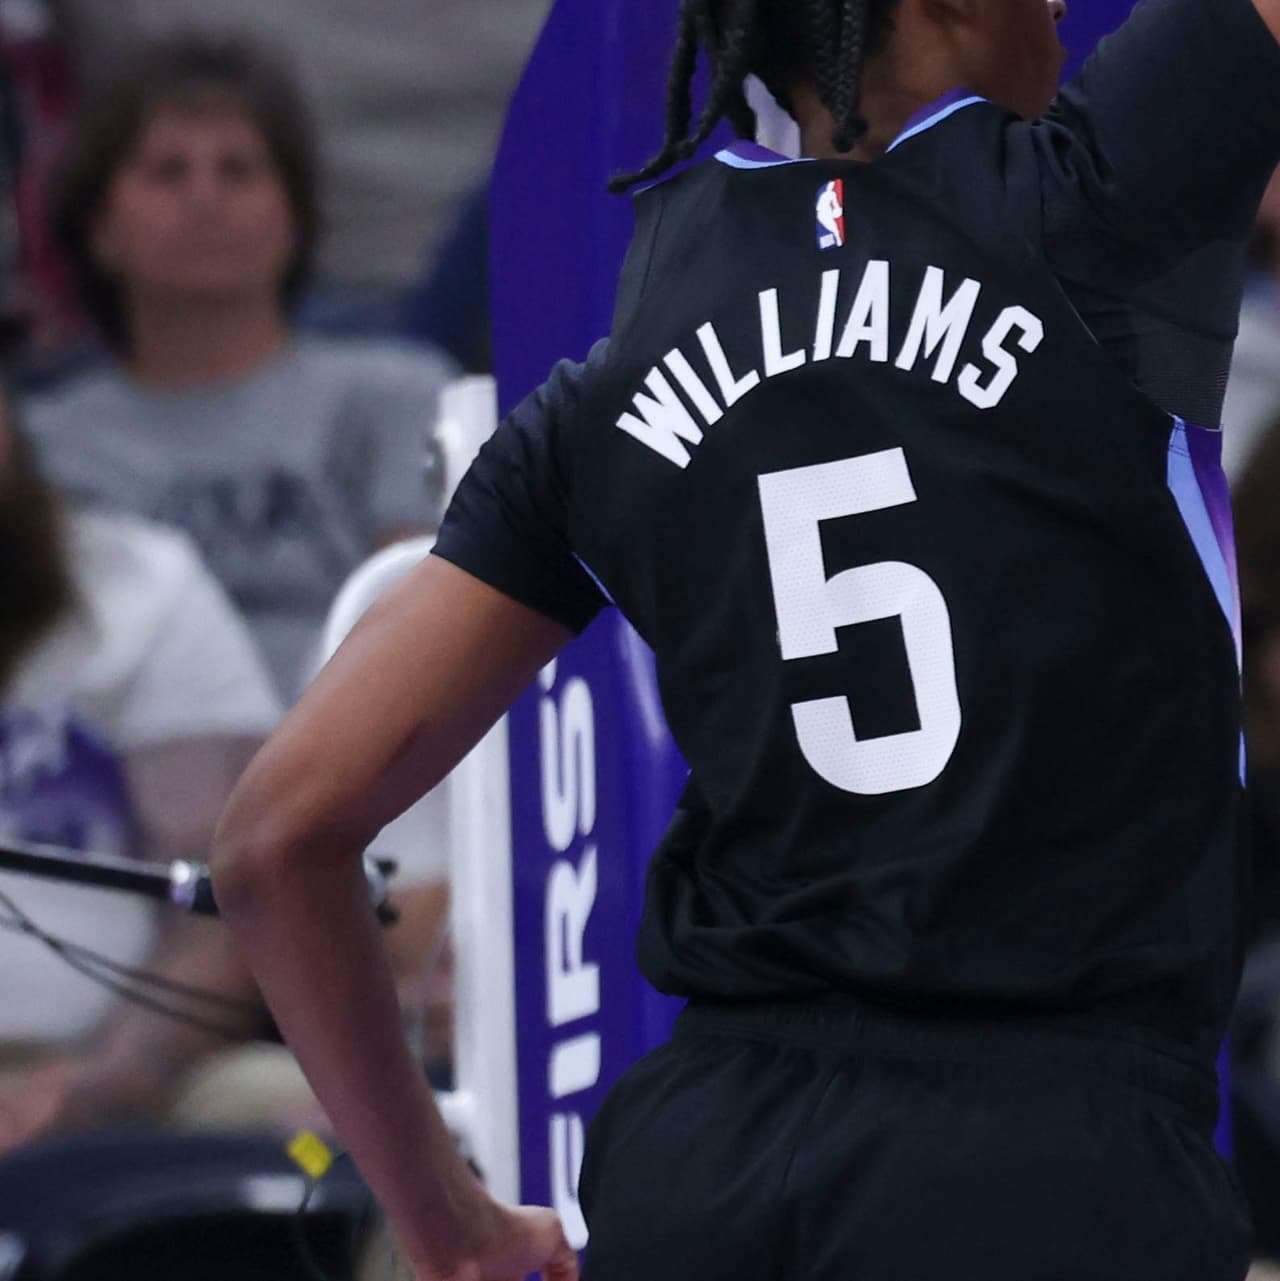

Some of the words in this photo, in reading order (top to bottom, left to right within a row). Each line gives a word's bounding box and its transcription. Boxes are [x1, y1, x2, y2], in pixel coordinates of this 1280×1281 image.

[616, 259, 1044, 469] WILLIAMS
[757, 447, 962, 795] 5
[538, 657, 601, 1251] FIRS
